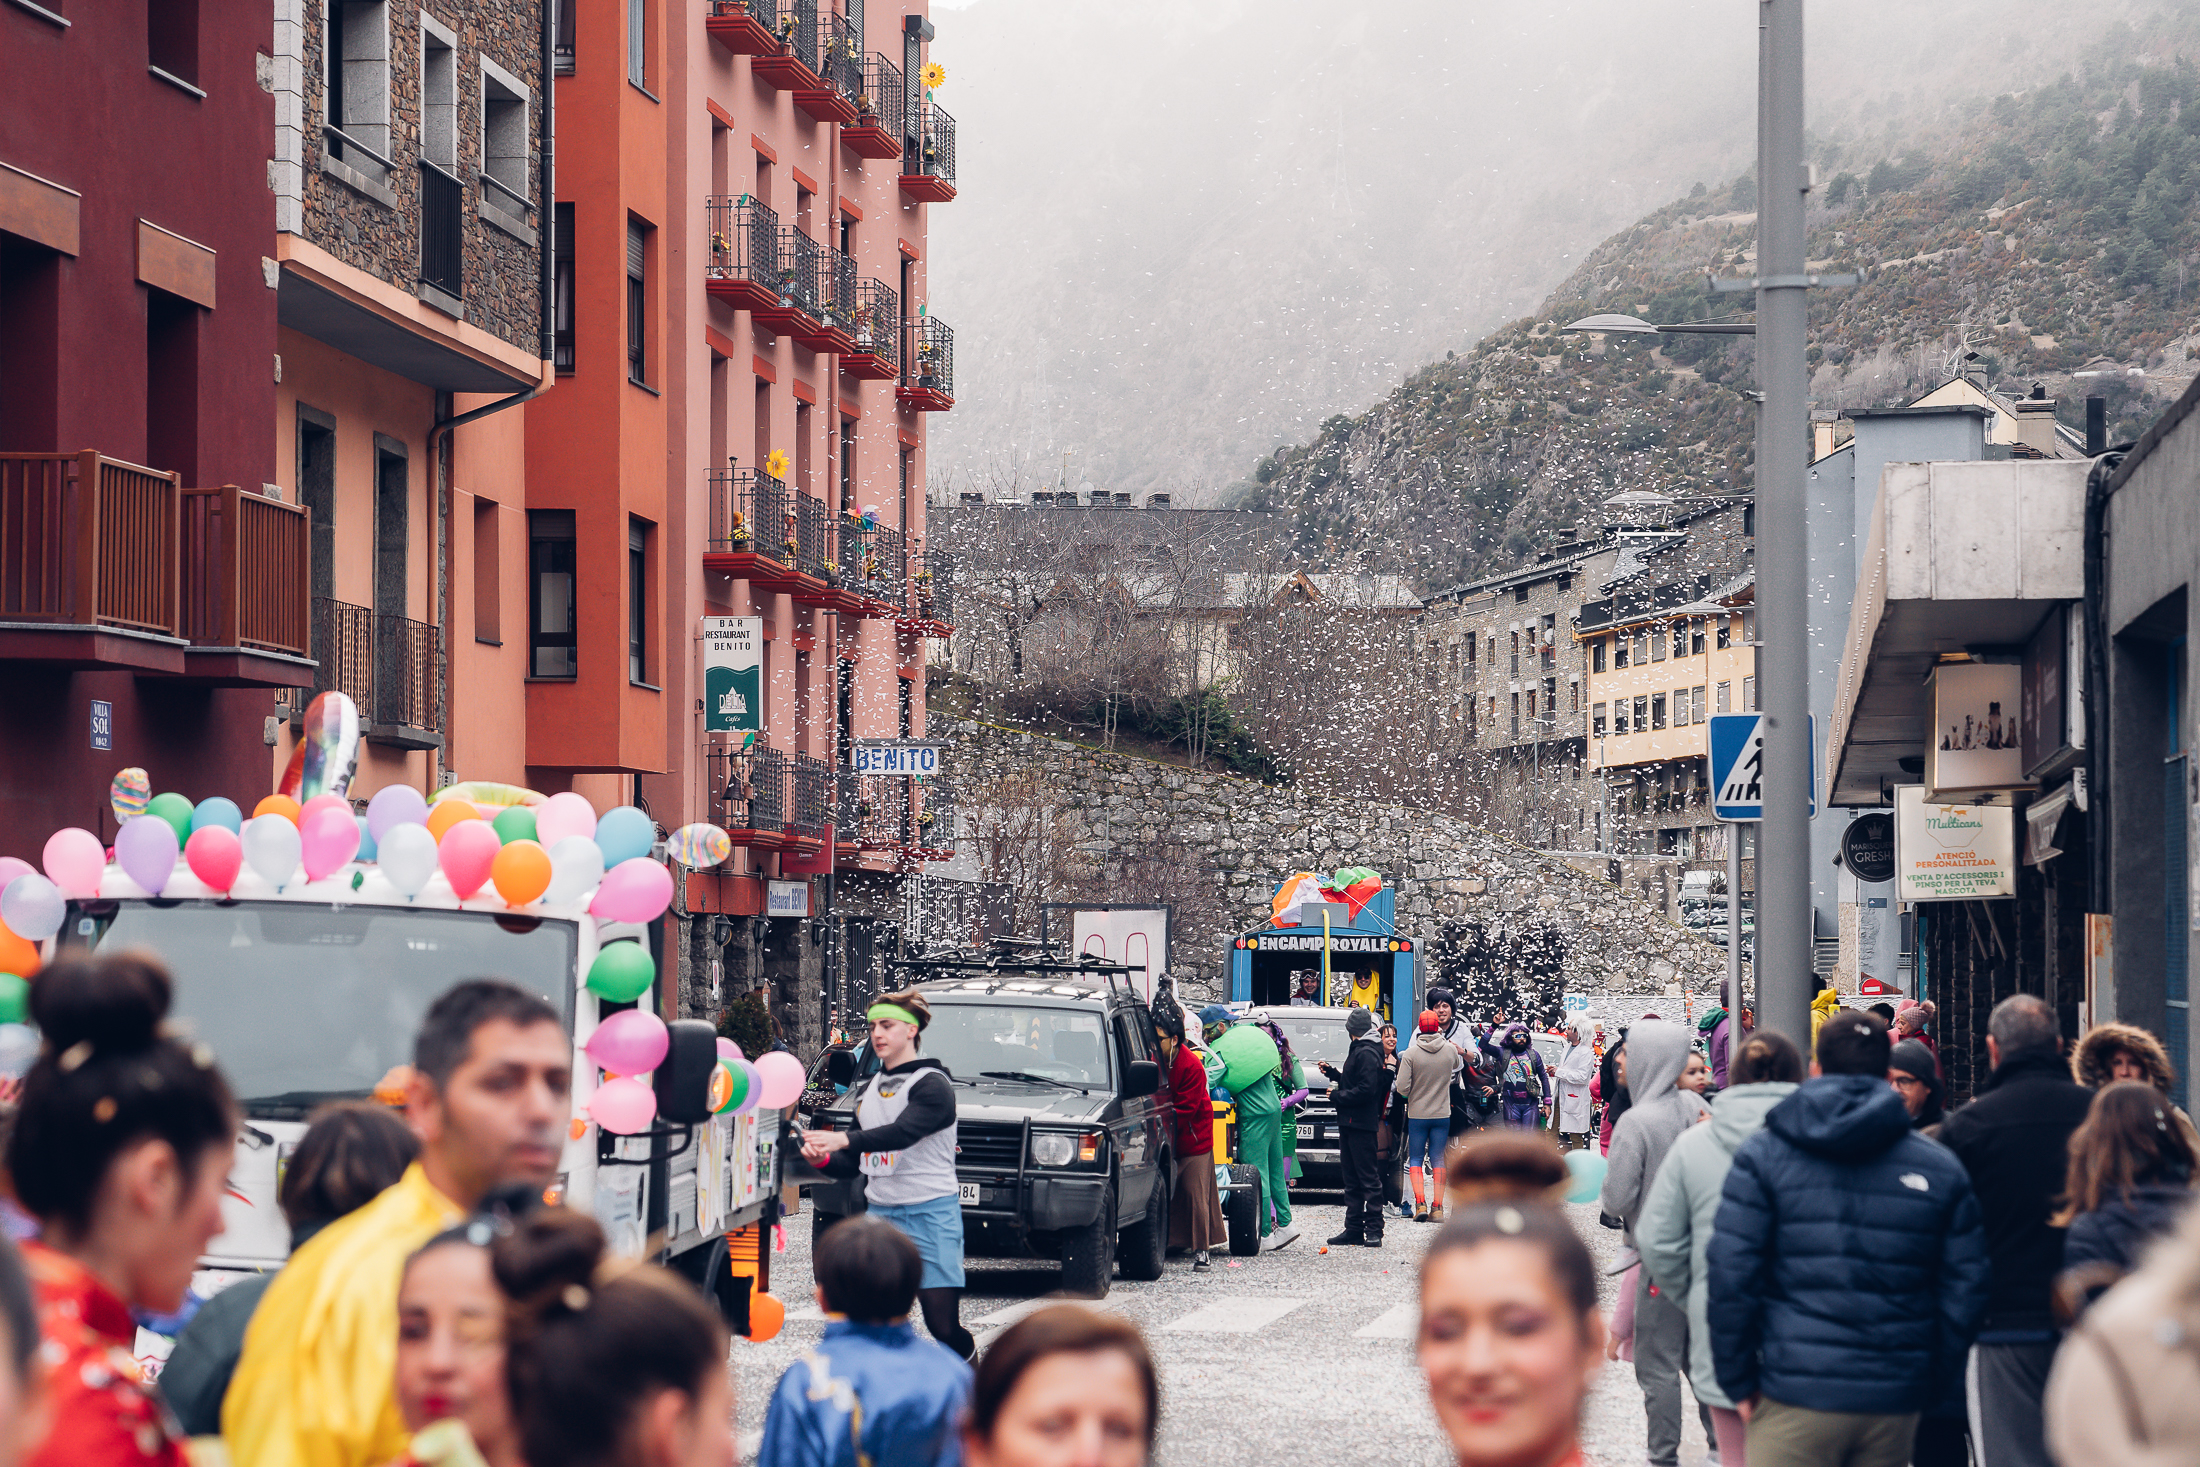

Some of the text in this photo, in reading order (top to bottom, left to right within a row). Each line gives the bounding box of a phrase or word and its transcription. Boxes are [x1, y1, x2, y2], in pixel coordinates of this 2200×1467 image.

[719, 619, 743, 628] BAR
[705, 630, 751, 639] RESTAURANT
[714, 642, 751, 650] BENITO
[719, 694, 747, 709] DELTA
[93, 703, 108, 717] VILLA
[92, 716, 109, 735] SOL
[856, 748, 934, 771] BENITO
[1926, 815, 1983, 830] Multicans
[1935, 849, 1976, 860] ATENCIÓ
[1915, 858, 1997, 869] PERSONALITZADA
[1906, 870, 2005, 882] VENTA D'ACCESSORIS I
[1962, 879, 1973, 887] LA
[1974, 879, 1997, 887] TEVA
[1935, 887, 1977, 895] MASCOTA
[791, 887, 807, 911] BENITO
[1259, 936, 1388, 952] ENCAMP ROYALE
[1296, 1126, 1312, 1135] 760
